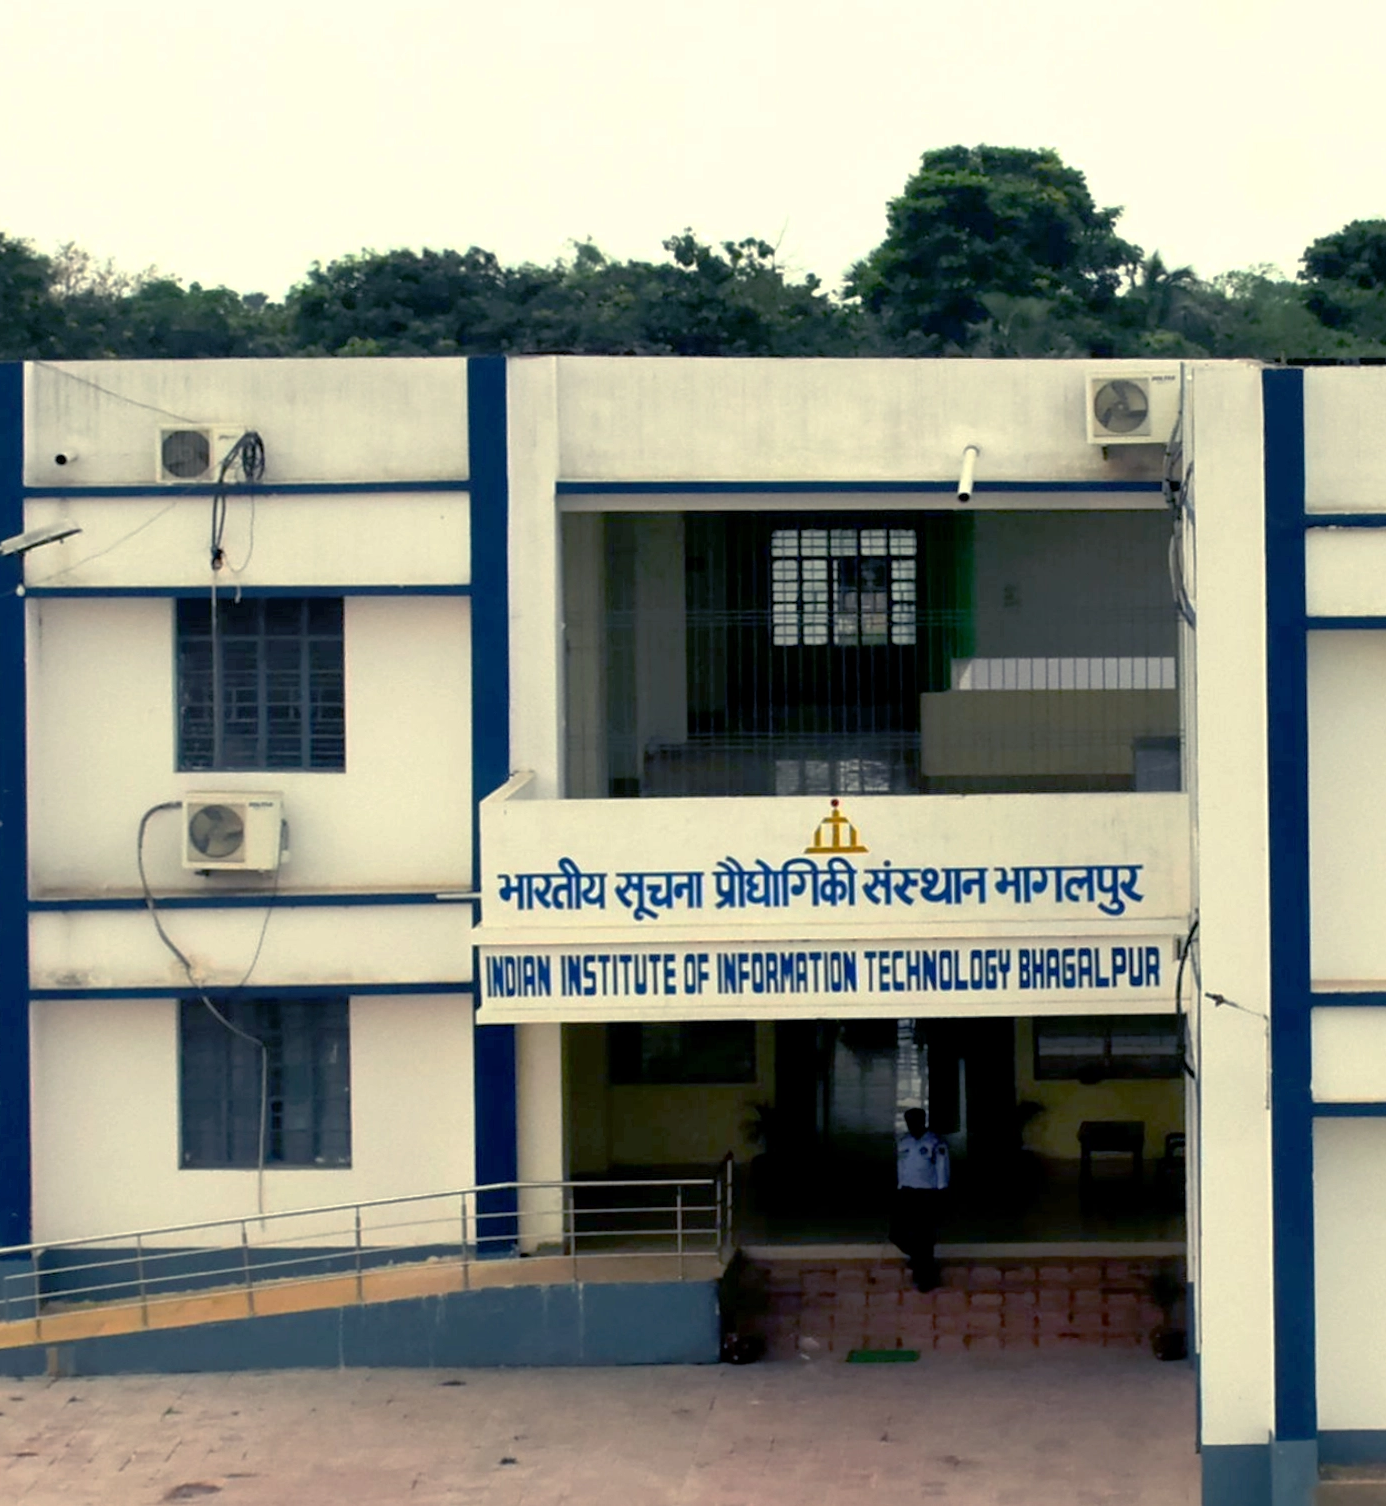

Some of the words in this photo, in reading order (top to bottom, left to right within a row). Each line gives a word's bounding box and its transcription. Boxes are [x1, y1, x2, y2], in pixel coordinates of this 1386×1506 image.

[498, 857, 607, 910] भारतीय
[614, 871, 704, 921] सूचना
[862, 860, 988, 906] संस्थान
[994, 864, 1144, 916] भागलपुर
[486, 955, 551, 997] INDIAN
[560, 953, 677, 996] INSTITUTE
[684, 953, 710, 995] OF
[717, 951, 857, 994] INFORMATION
[863, 949, 1011, 992] TECHNOLOGY
[1018, 946, 1160, 990] BHAGALPUR
